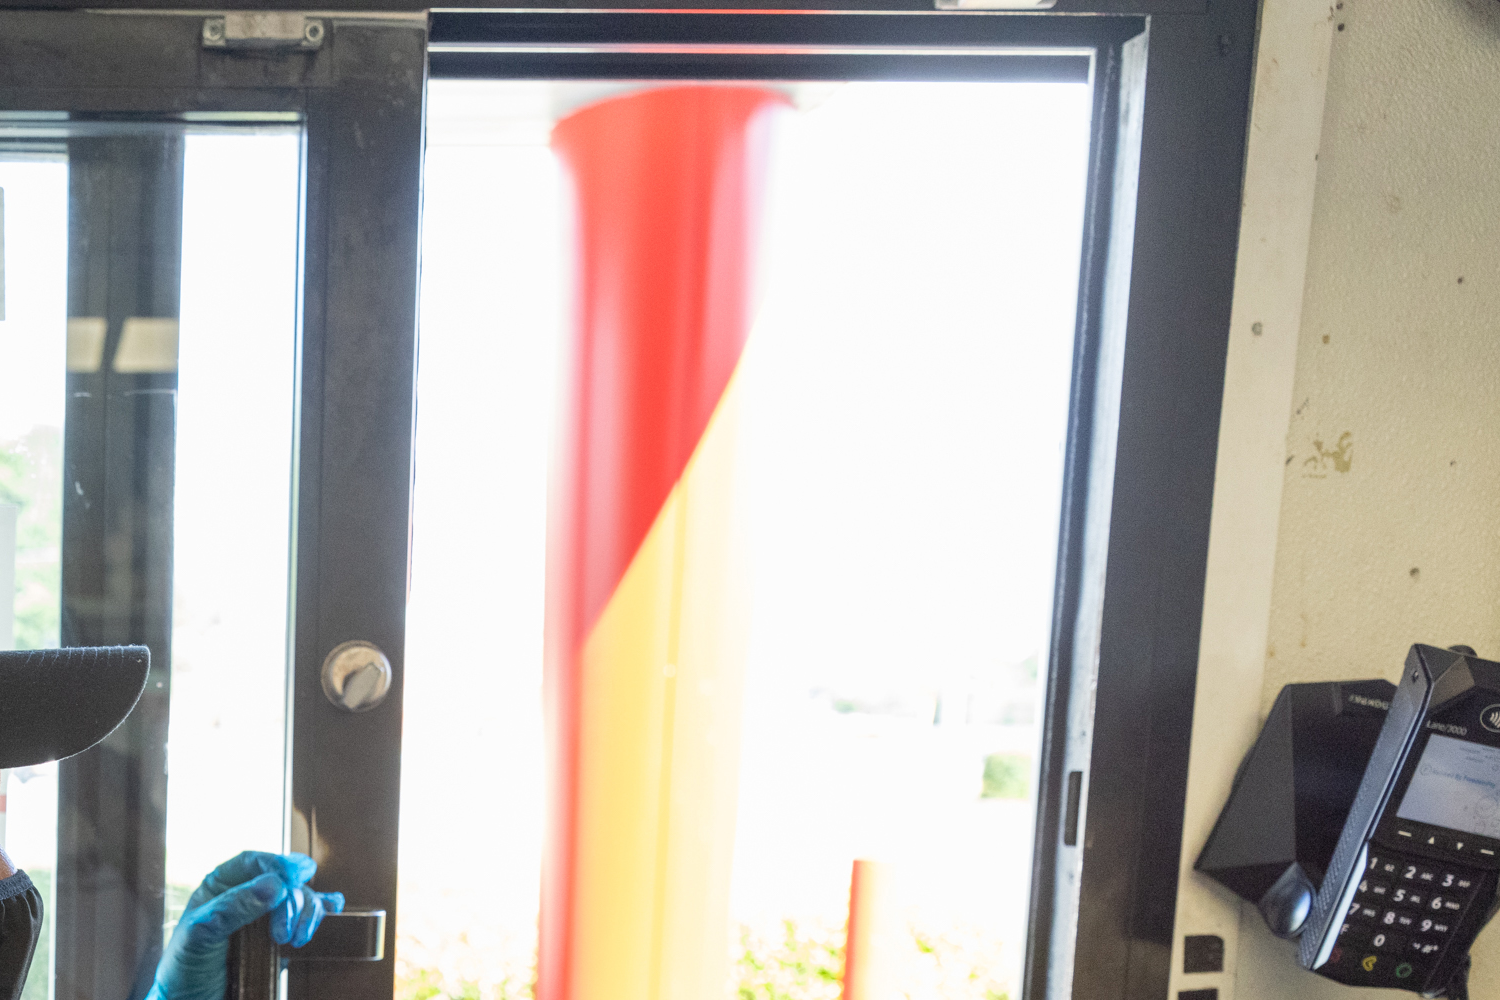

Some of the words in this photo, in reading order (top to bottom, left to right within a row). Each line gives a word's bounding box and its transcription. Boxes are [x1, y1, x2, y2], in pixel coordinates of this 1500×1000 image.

[1404, 865, 1417, 879] 2
[1441, 873, 1455, 887] 3
[1393, 888, 1406, 902] 5
[1431, 896, 1442, 910] 6
[1348, 902, 1360, 915] 7
[1383, 911, 1396, 925] 8
[1420, 919, 1433, 932] 9
[1373, 933, 1386, 947] 0
